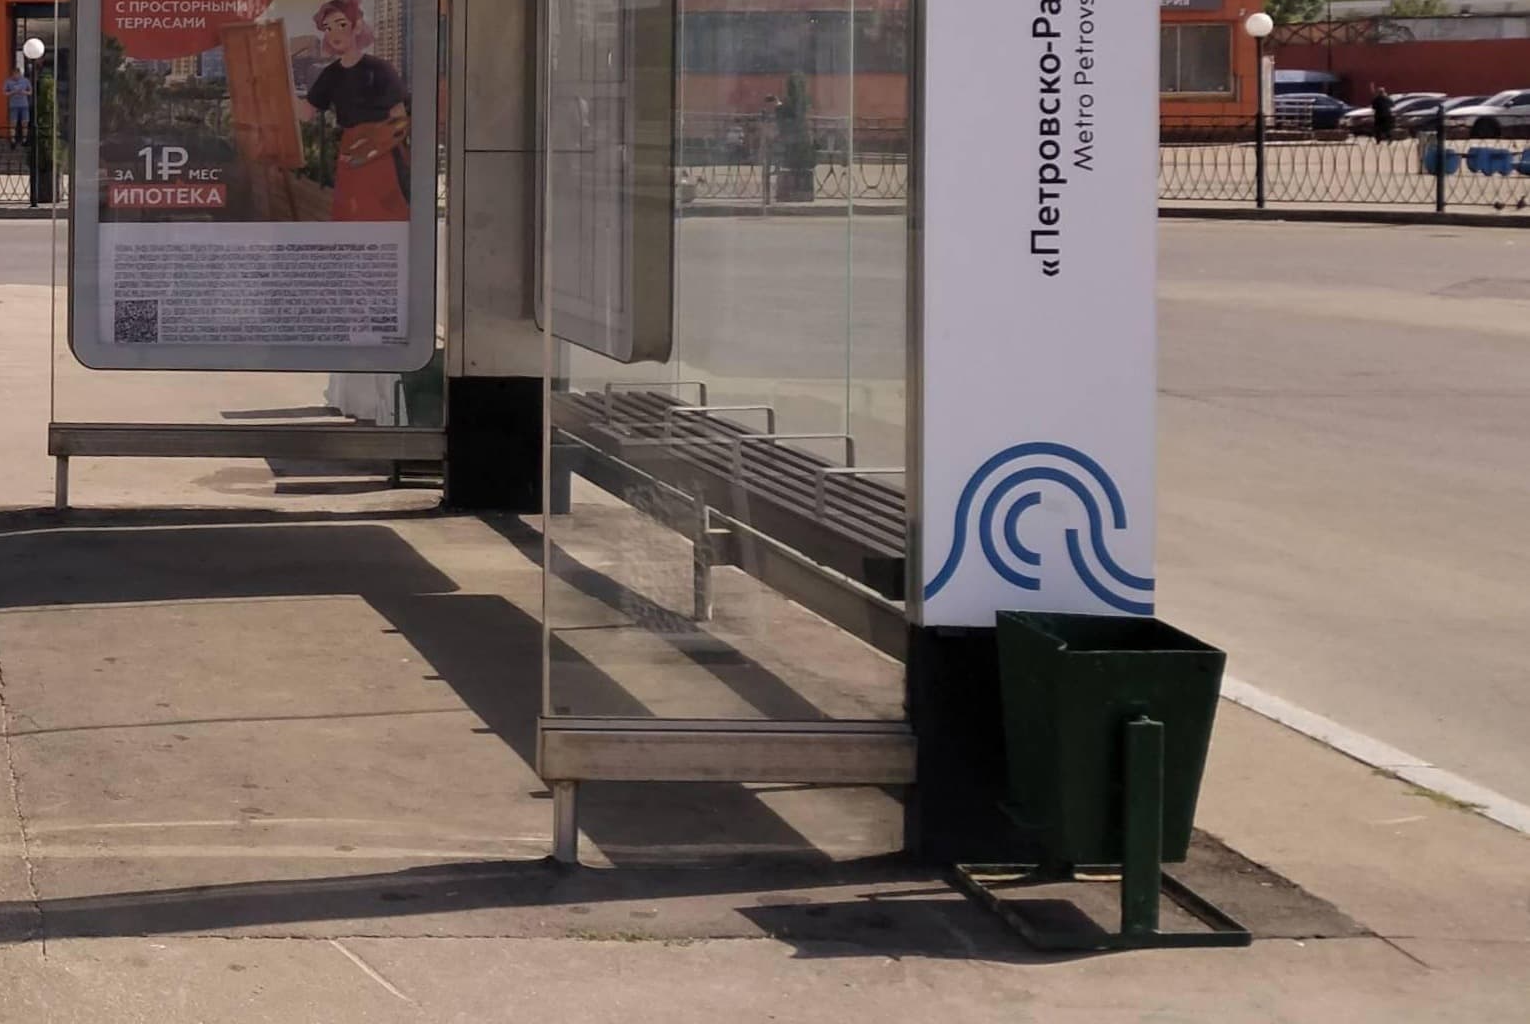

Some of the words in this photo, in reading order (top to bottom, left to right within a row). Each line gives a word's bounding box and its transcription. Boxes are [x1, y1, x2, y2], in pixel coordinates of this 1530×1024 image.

[116, 1, 126, 13] С
[129, 0, 248, 13] ПРОСТОРНЫМИ
[116, 17, 206, 29] ТЕРРАСАМИ
[1073, 93, 1094, 172] Metro
[114, 169, 135, 181] ЗА
[113, 187, 223, 205] ИПОТЕКА
